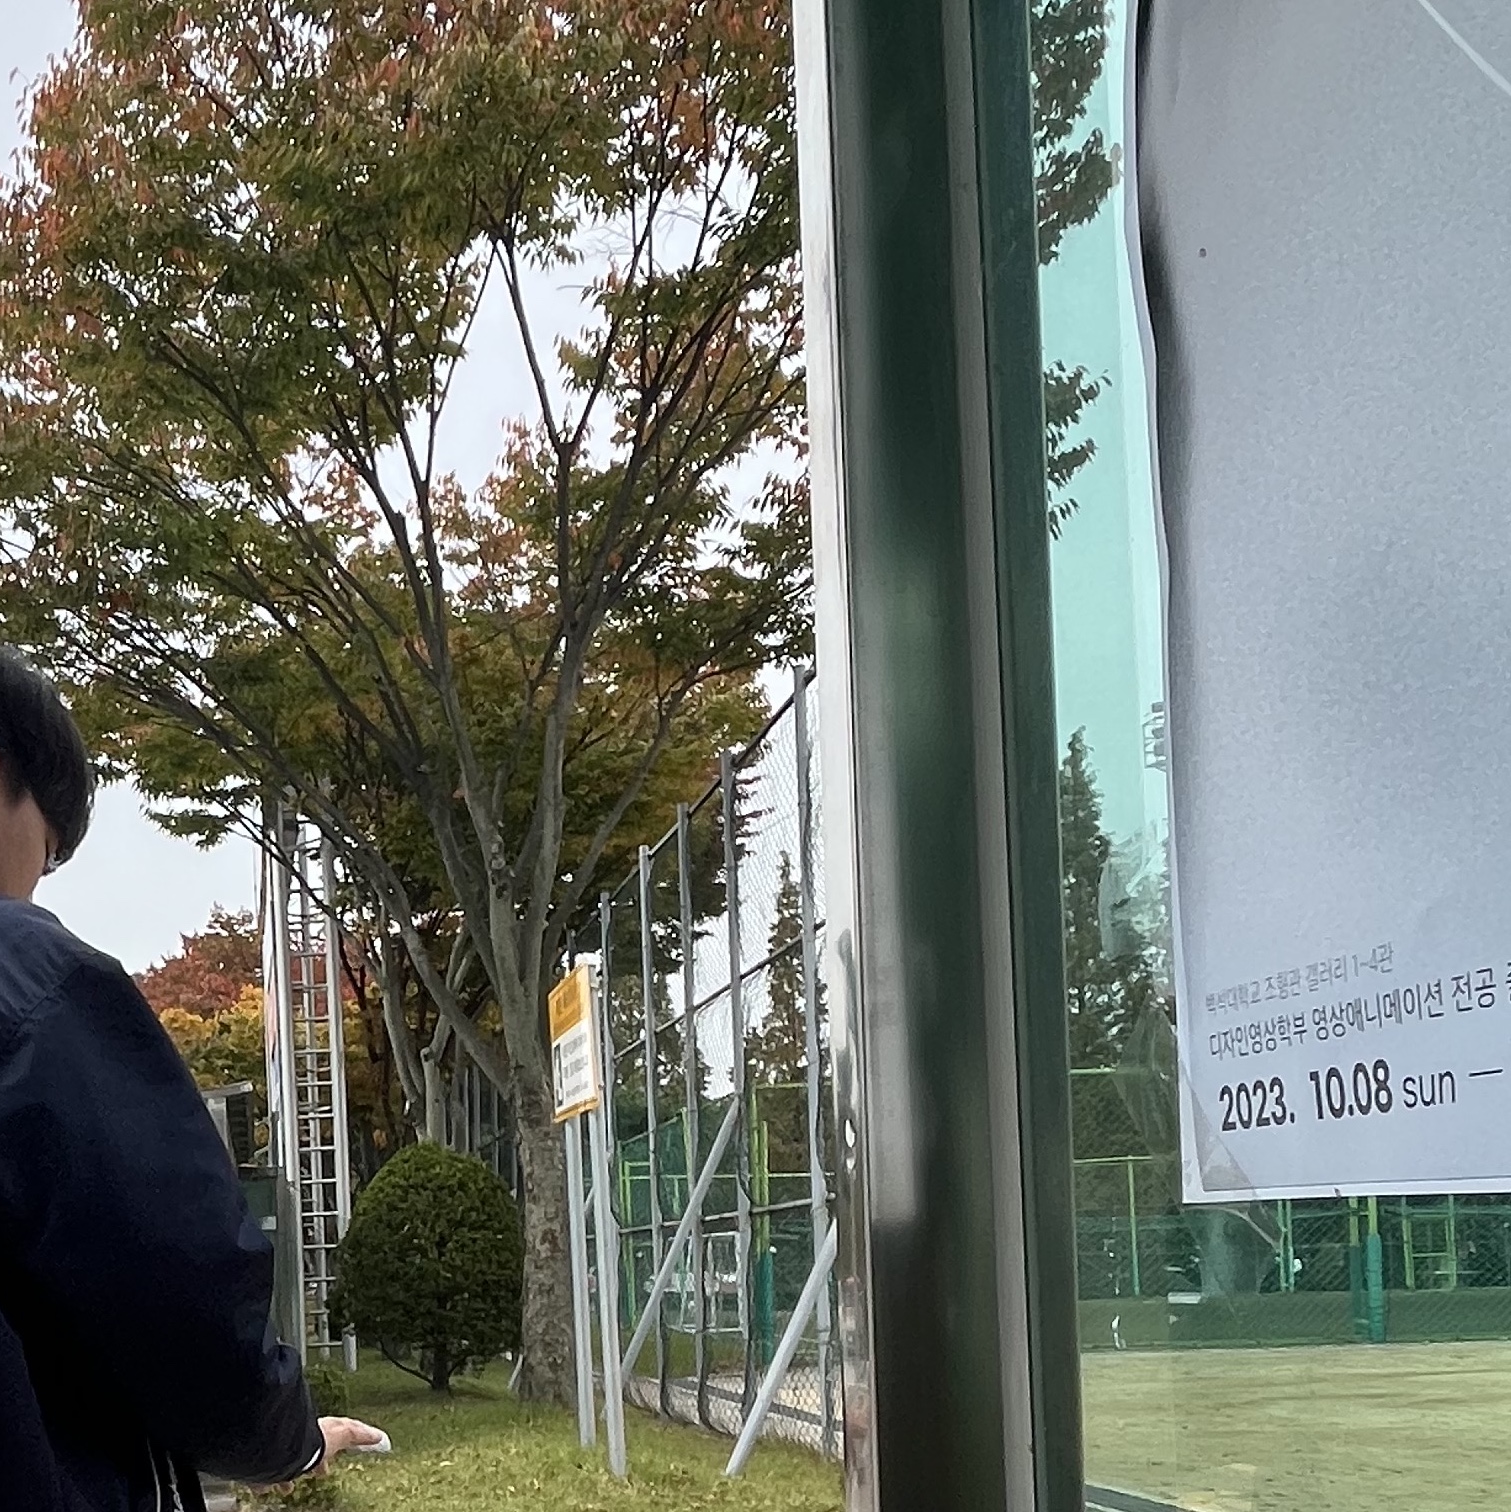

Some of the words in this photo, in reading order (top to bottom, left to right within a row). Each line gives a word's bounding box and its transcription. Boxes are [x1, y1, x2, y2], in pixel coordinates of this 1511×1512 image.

[1305, 954, 1349, 992] 갤러리
[1208, 1011, 1308, 1060] 디자인영상학부
[1311, 977, 1445, 1041] 영상애니메이션
[1450, 967, 1497, 1012] 전공
[1218, 1075, 1296, 1132] 2023.
[1308, 1058, 1394, 1121] 10.08
[1402, 1069, 1457, 1109] sun
